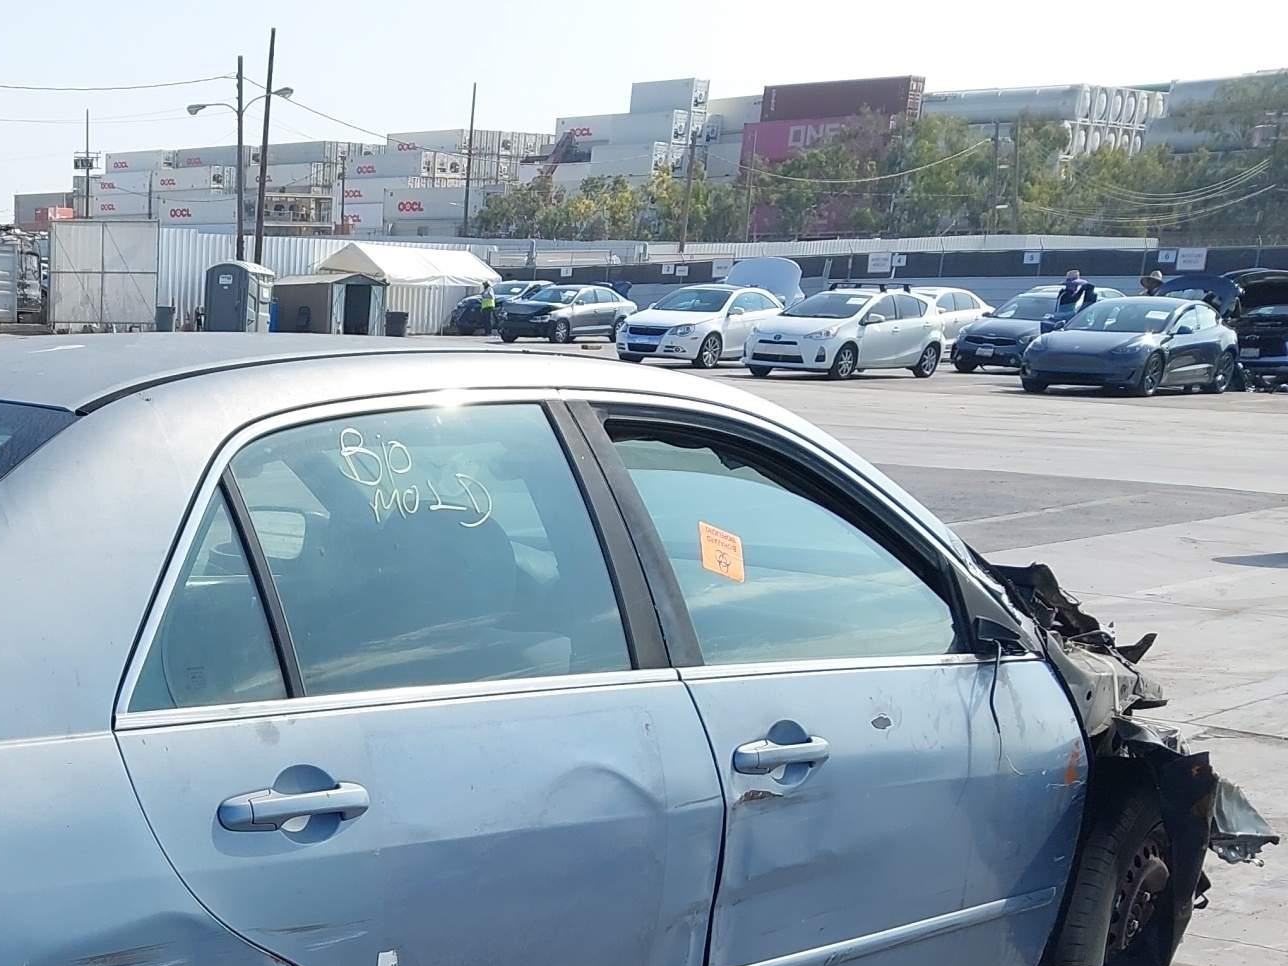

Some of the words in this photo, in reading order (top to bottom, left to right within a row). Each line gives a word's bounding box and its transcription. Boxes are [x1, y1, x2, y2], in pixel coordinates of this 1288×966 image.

[397, 143, 417, 151] OOCL
[356, 165, 376, 174] OOCL
[397, 201, 424, 212] OOCL
[169, 208, 192, 218] OOCL
[369, 473, 492, 528] MOLD
